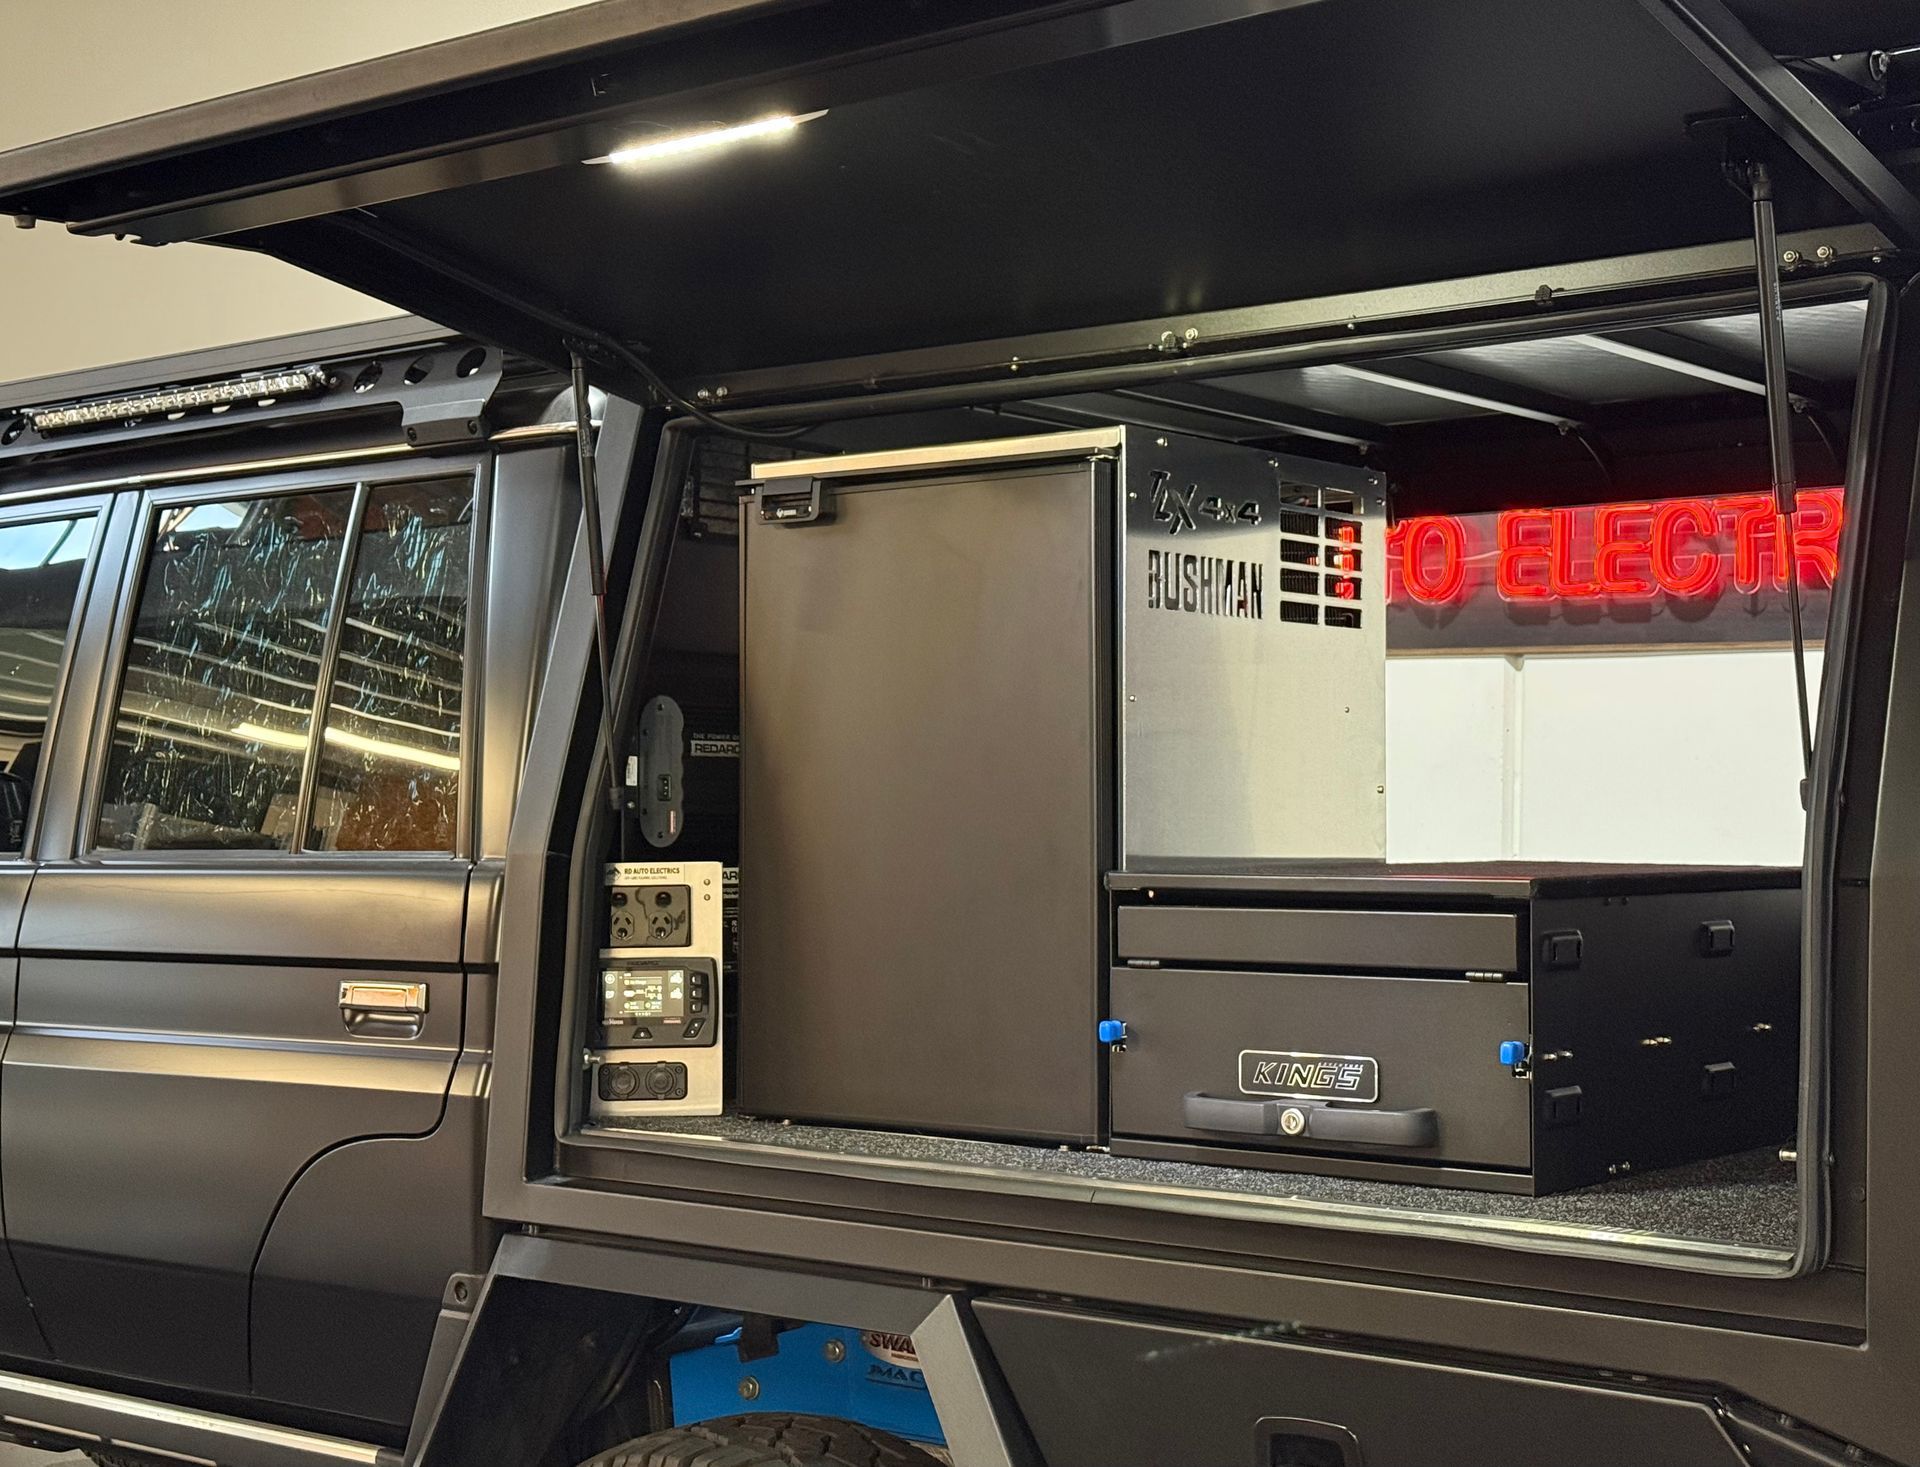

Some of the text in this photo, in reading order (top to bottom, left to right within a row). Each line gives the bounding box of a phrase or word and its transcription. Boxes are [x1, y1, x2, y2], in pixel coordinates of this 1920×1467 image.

[1148, 549, 1263, 619] BUSHMAN
[633, 867, 649, 875] AUTO
[1253, 1061, 1363, 1090] KINGS
